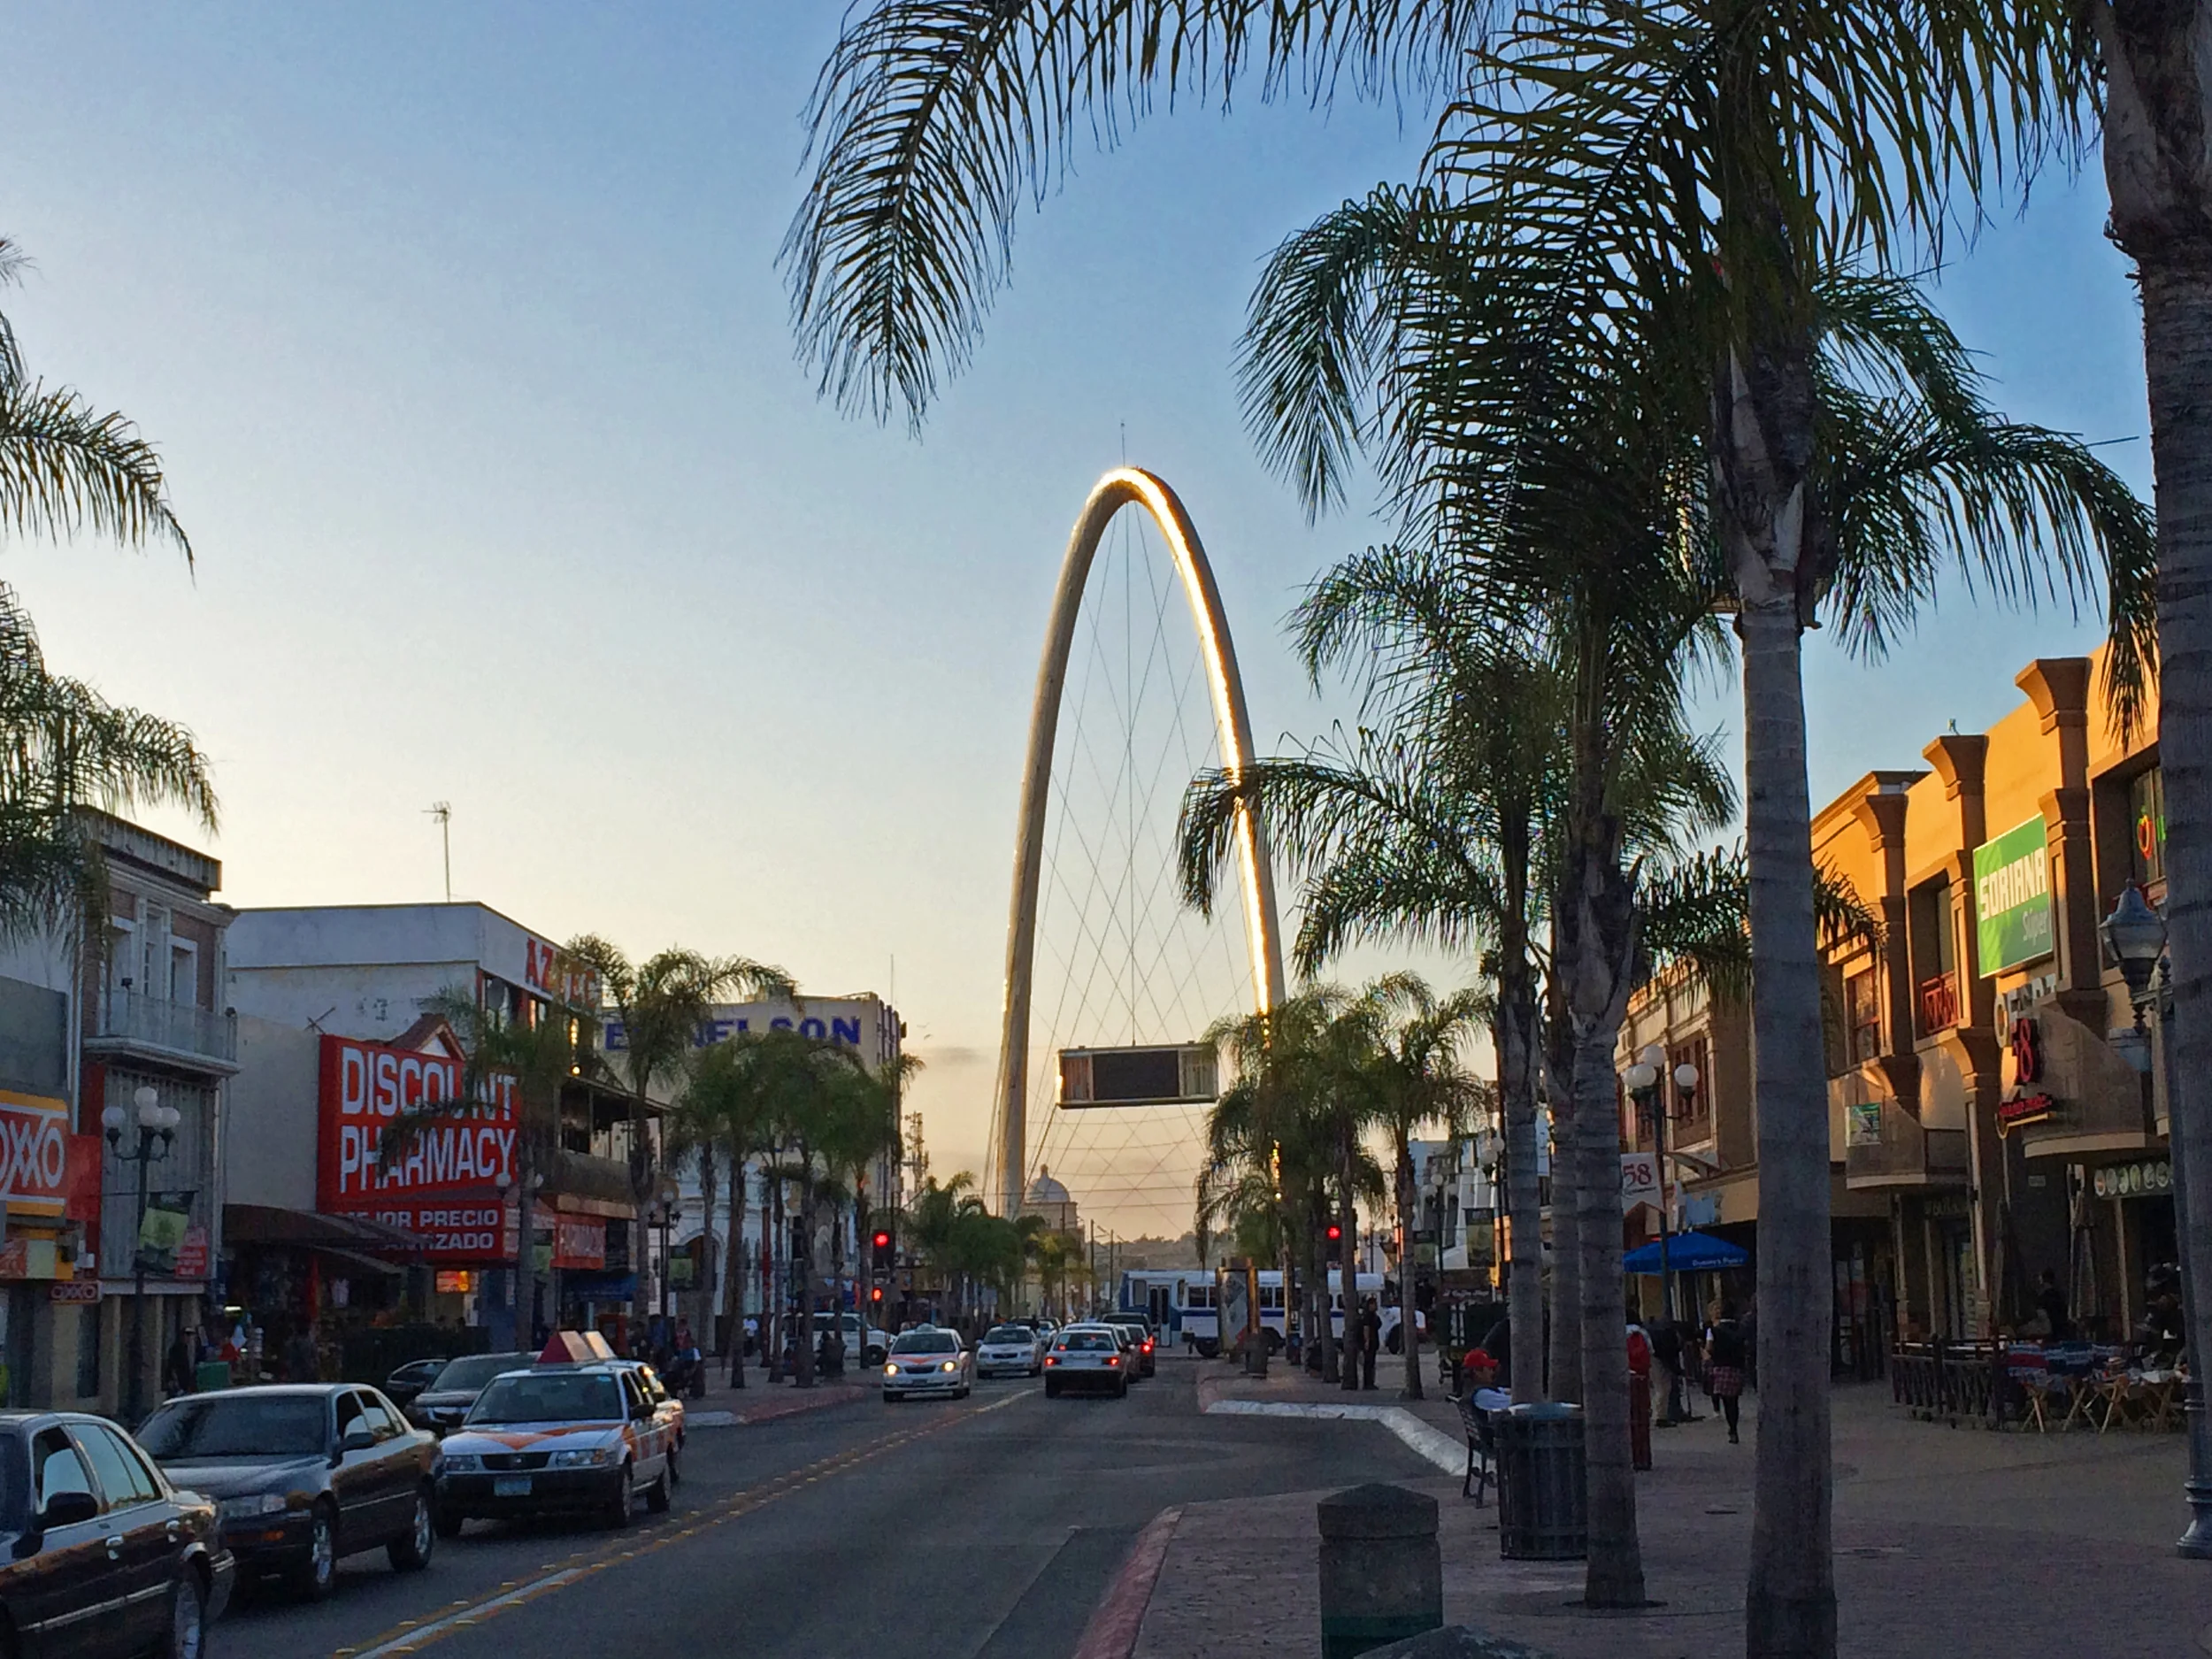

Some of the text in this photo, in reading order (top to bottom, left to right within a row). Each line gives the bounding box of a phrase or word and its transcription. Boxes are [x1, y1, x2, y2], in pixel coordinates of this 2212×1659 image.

[1978, 847, 2047, 922] SORIANA
[1623, 1163, 1652, 1187] 58
[419, 1209, 499, 1227] PRECIO
[50, 1284, 97, 1300] OXXO
